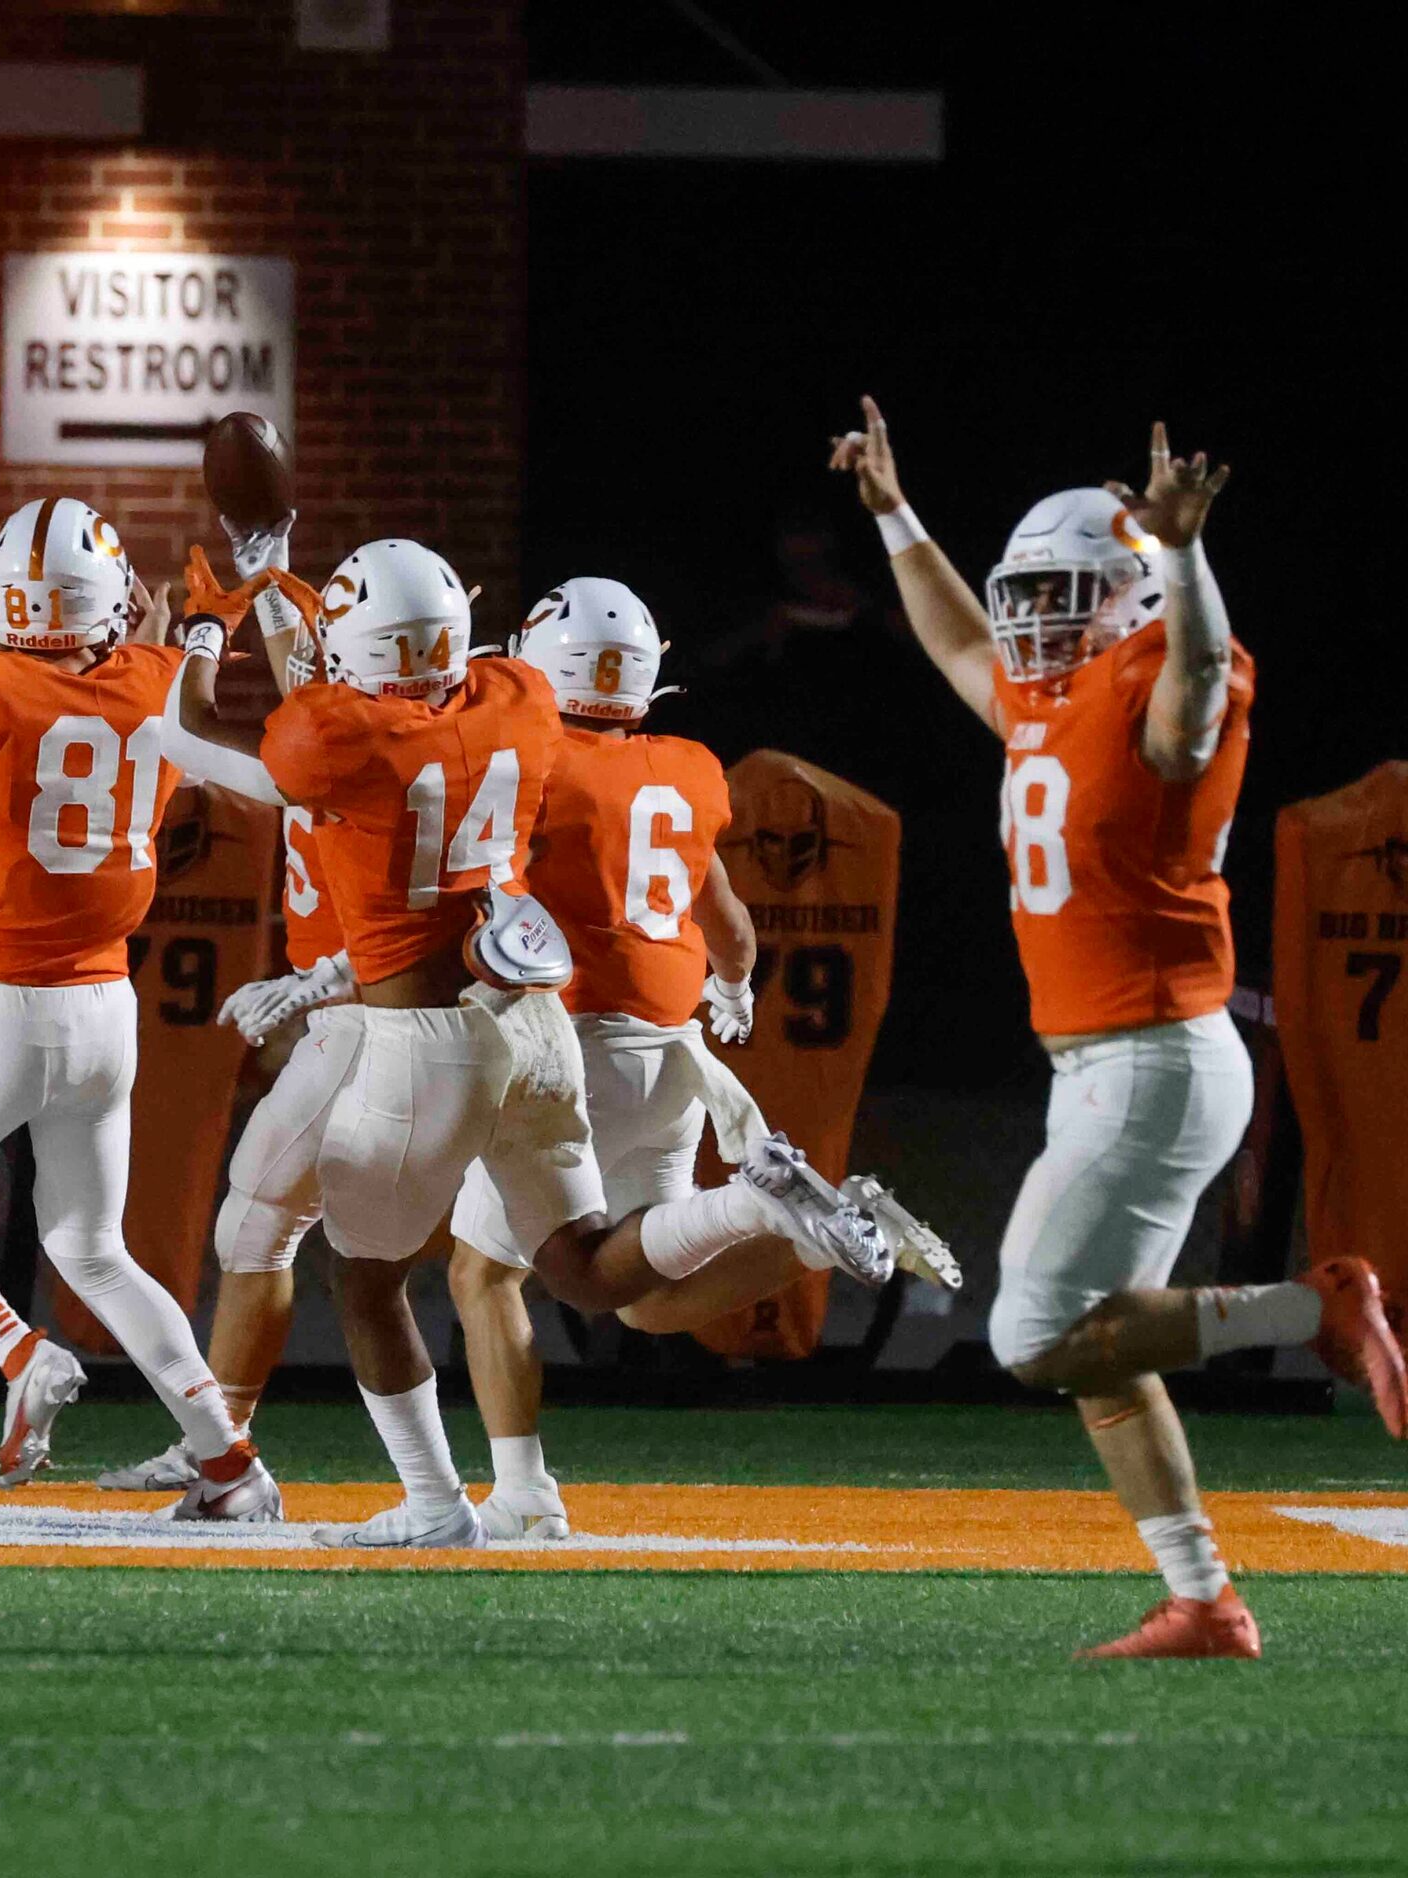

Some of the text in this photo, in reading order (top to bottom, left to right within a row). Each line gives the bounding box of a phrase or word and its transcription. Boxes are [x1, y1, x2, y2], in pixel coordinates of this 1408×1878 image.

[59, 270, 240, 318] VISITOR
[24, 340, 275, 391] RESTROOM
[5, 588, 64, 631] 81
[6, 633, 77, 648] Riddell
[382, 673, 455, 696] Riddell
[595, 650, 623, 695] 6
[566, 699, 635, 718] Riddell
[28, 716, 162, 873] 81
[407, 748, 519, 909] 14
[625, 785, 693, 940] 6
